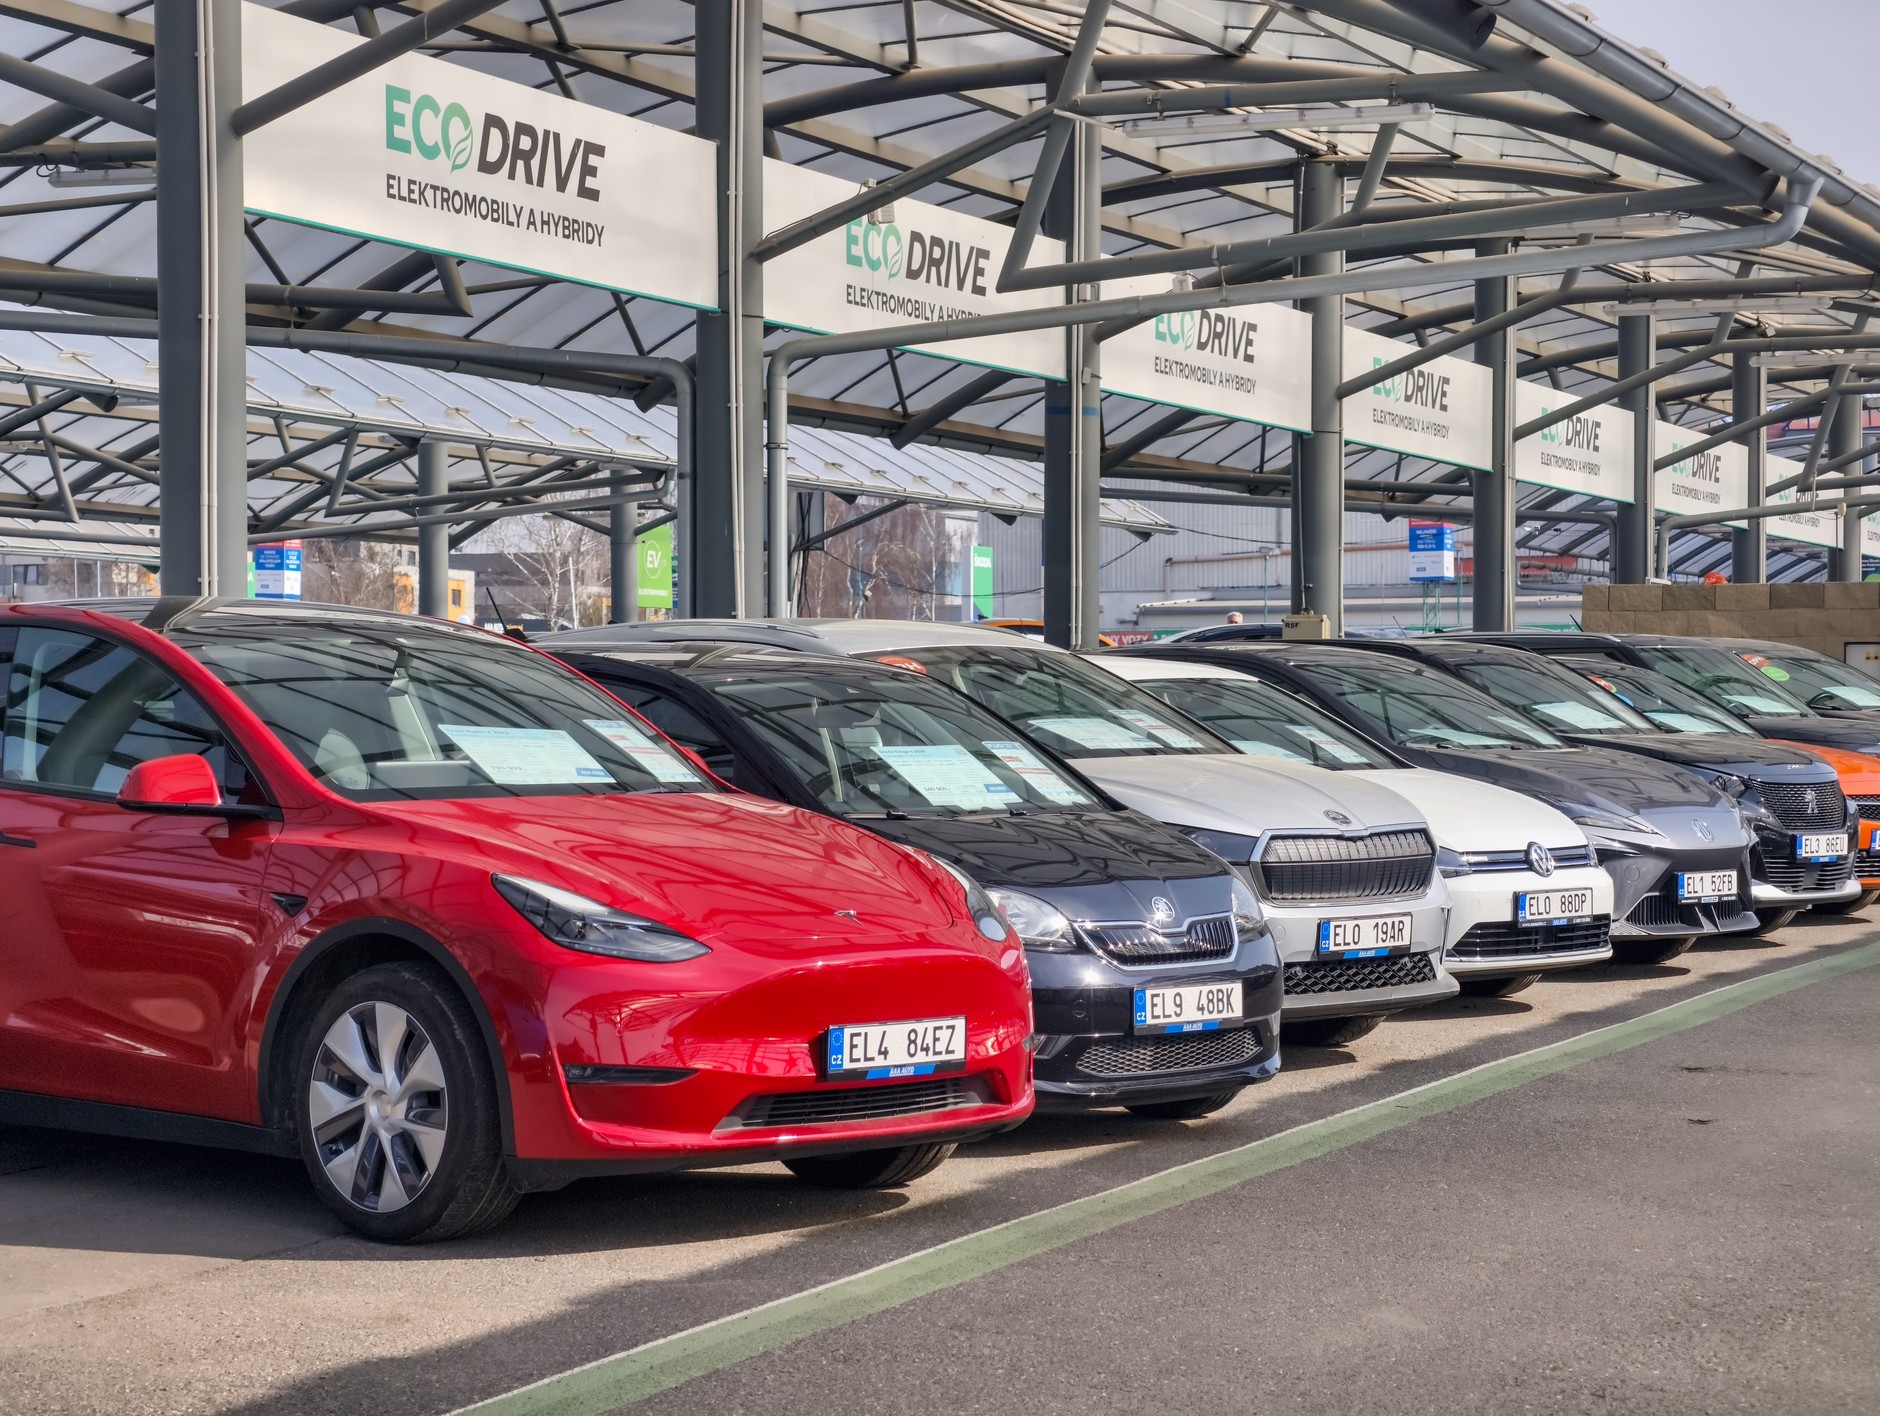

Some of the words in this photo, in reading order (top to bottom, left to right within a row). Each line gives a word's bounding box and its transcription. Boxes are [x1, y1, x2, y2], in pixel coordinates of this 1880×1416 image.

[386, 84, 474, 174] ECO
[477, 113, 606, 202] DRIVE
[386, 173, 524, 231] ELEKTROMOBILY
[526, 208, 539, 233] A
[541, 213, 605, 247] HYBRIDY
[846, 217, 903, 281] ECO
[905, 230, 990, 297] DRIVE
[846, 284, 936, 322] ELEKTROMOBILY
[937, 304, 944, 322] A
[1155, 311, 1196, 351] ECO
[1197, 309, 1257, 363] DRIVE
[1154, 356, 1218, 386] ELEKTROMOBILY
[1218, 372, 1224, 387] A
[1225, 373, 1257, 395] HYBRIDY
[1404, 367, 1450, 412] DRIVE
[1373, 408, 1420, 432] ELEKTROMOBILY
[1421, 420, 1426, 434] A
[1426, 421, 1450, 439] HYBRIDY
[1565, 416, 1601, 452] DRIVE
[1692, 452, 1721, 483] DRIVE
[647, 551, 661, 568] EV
[1804, 838, 1820, 854] EL3
[1687, 876, 1704, 894] EL1
[1711, 874, 1732, 892] 52FB
[1560, 893, 1586, 914] 88DP
[1373, 920, 1405, 944] 19AR
[1136, 1011, 1146, 1020] CZ
[1150, 992, 1183, 1020] EL9
[1196, 987, 1234, 1015] 48BK
[831, 1054, 842, 1065] CZ
[849, 1030, 889, 1063] EL4
[907, 1024, 956, 1058] 84EZ
[890, 1067, 900, 1076] AAA
[901, 1066, 914, 1075] AUTO
